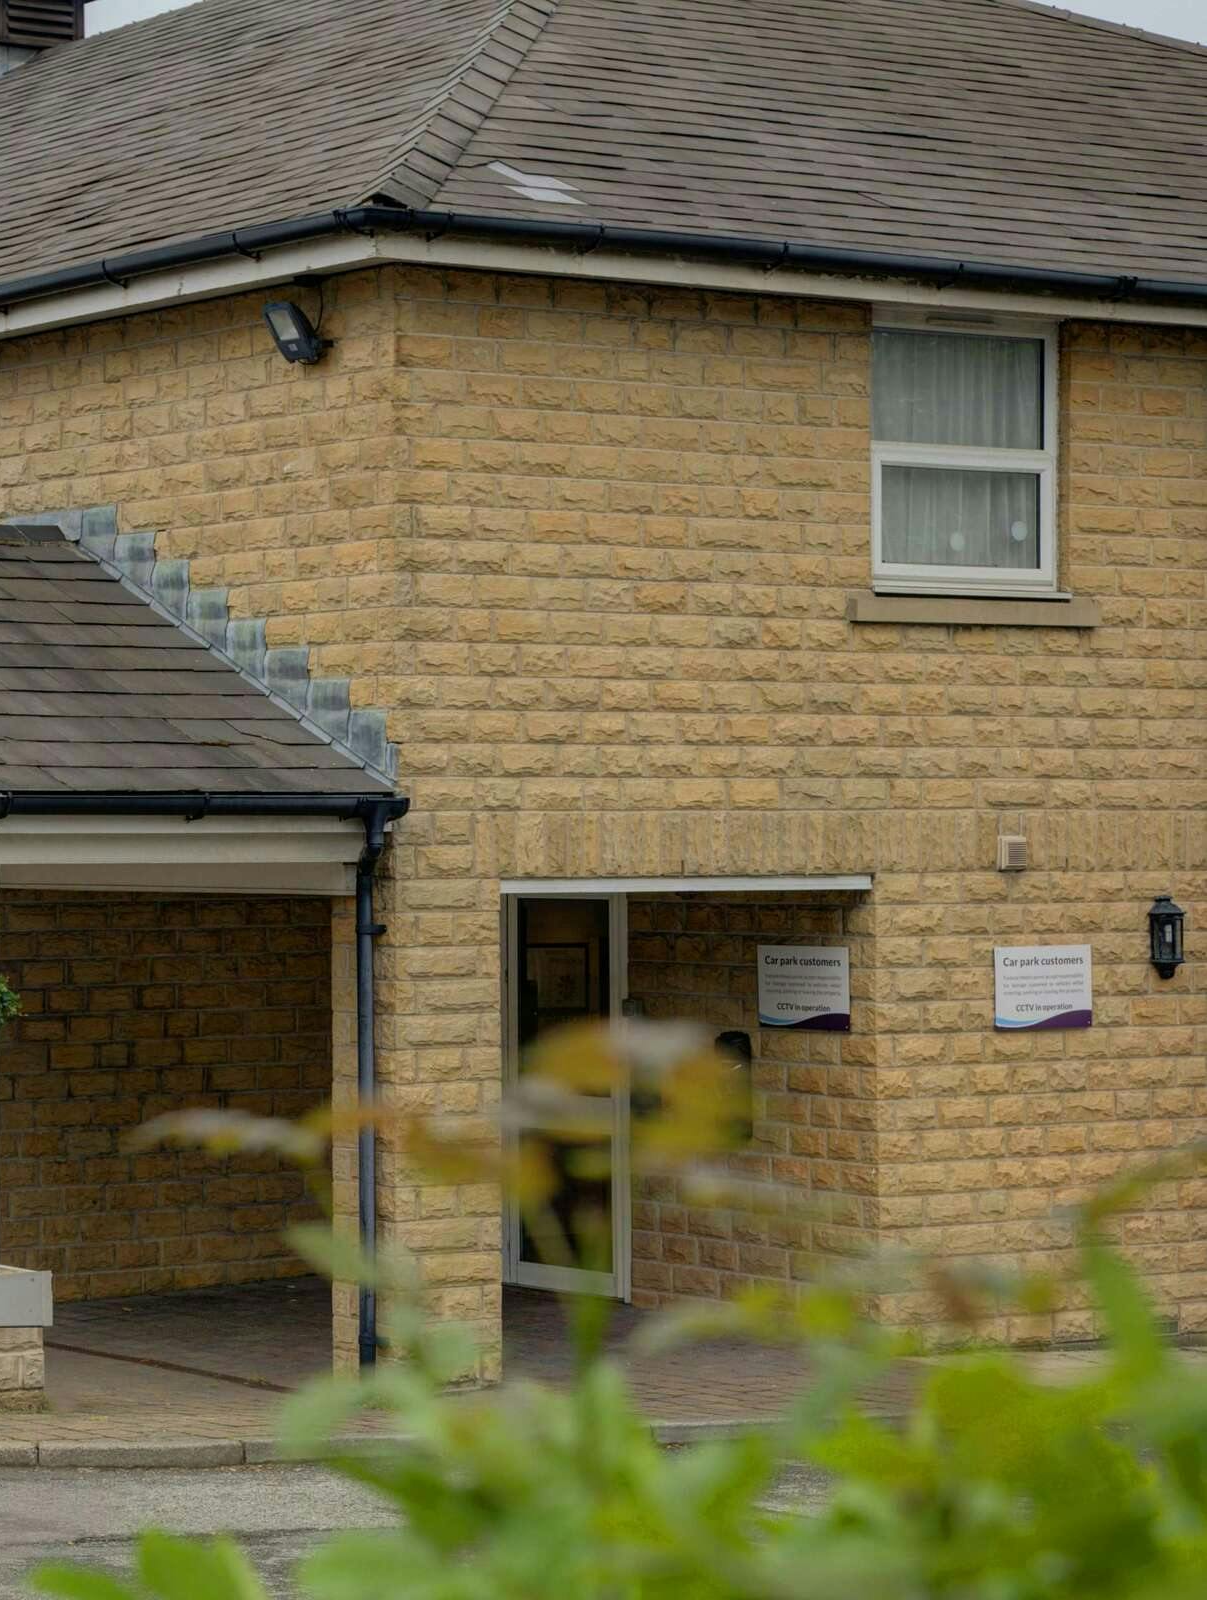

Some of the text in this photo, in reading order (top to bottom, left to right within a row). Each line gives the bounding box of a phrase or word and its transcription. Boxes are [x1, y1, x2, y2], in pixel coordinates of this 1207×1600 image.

[764, 955, 841, 967] Car park customers
[1002, 956, 1084, 968] Car park customers
[776, 1002, 831, 1013] CCTV in operation
[1015, 1002, 1073, 1012] CCTV in operation
